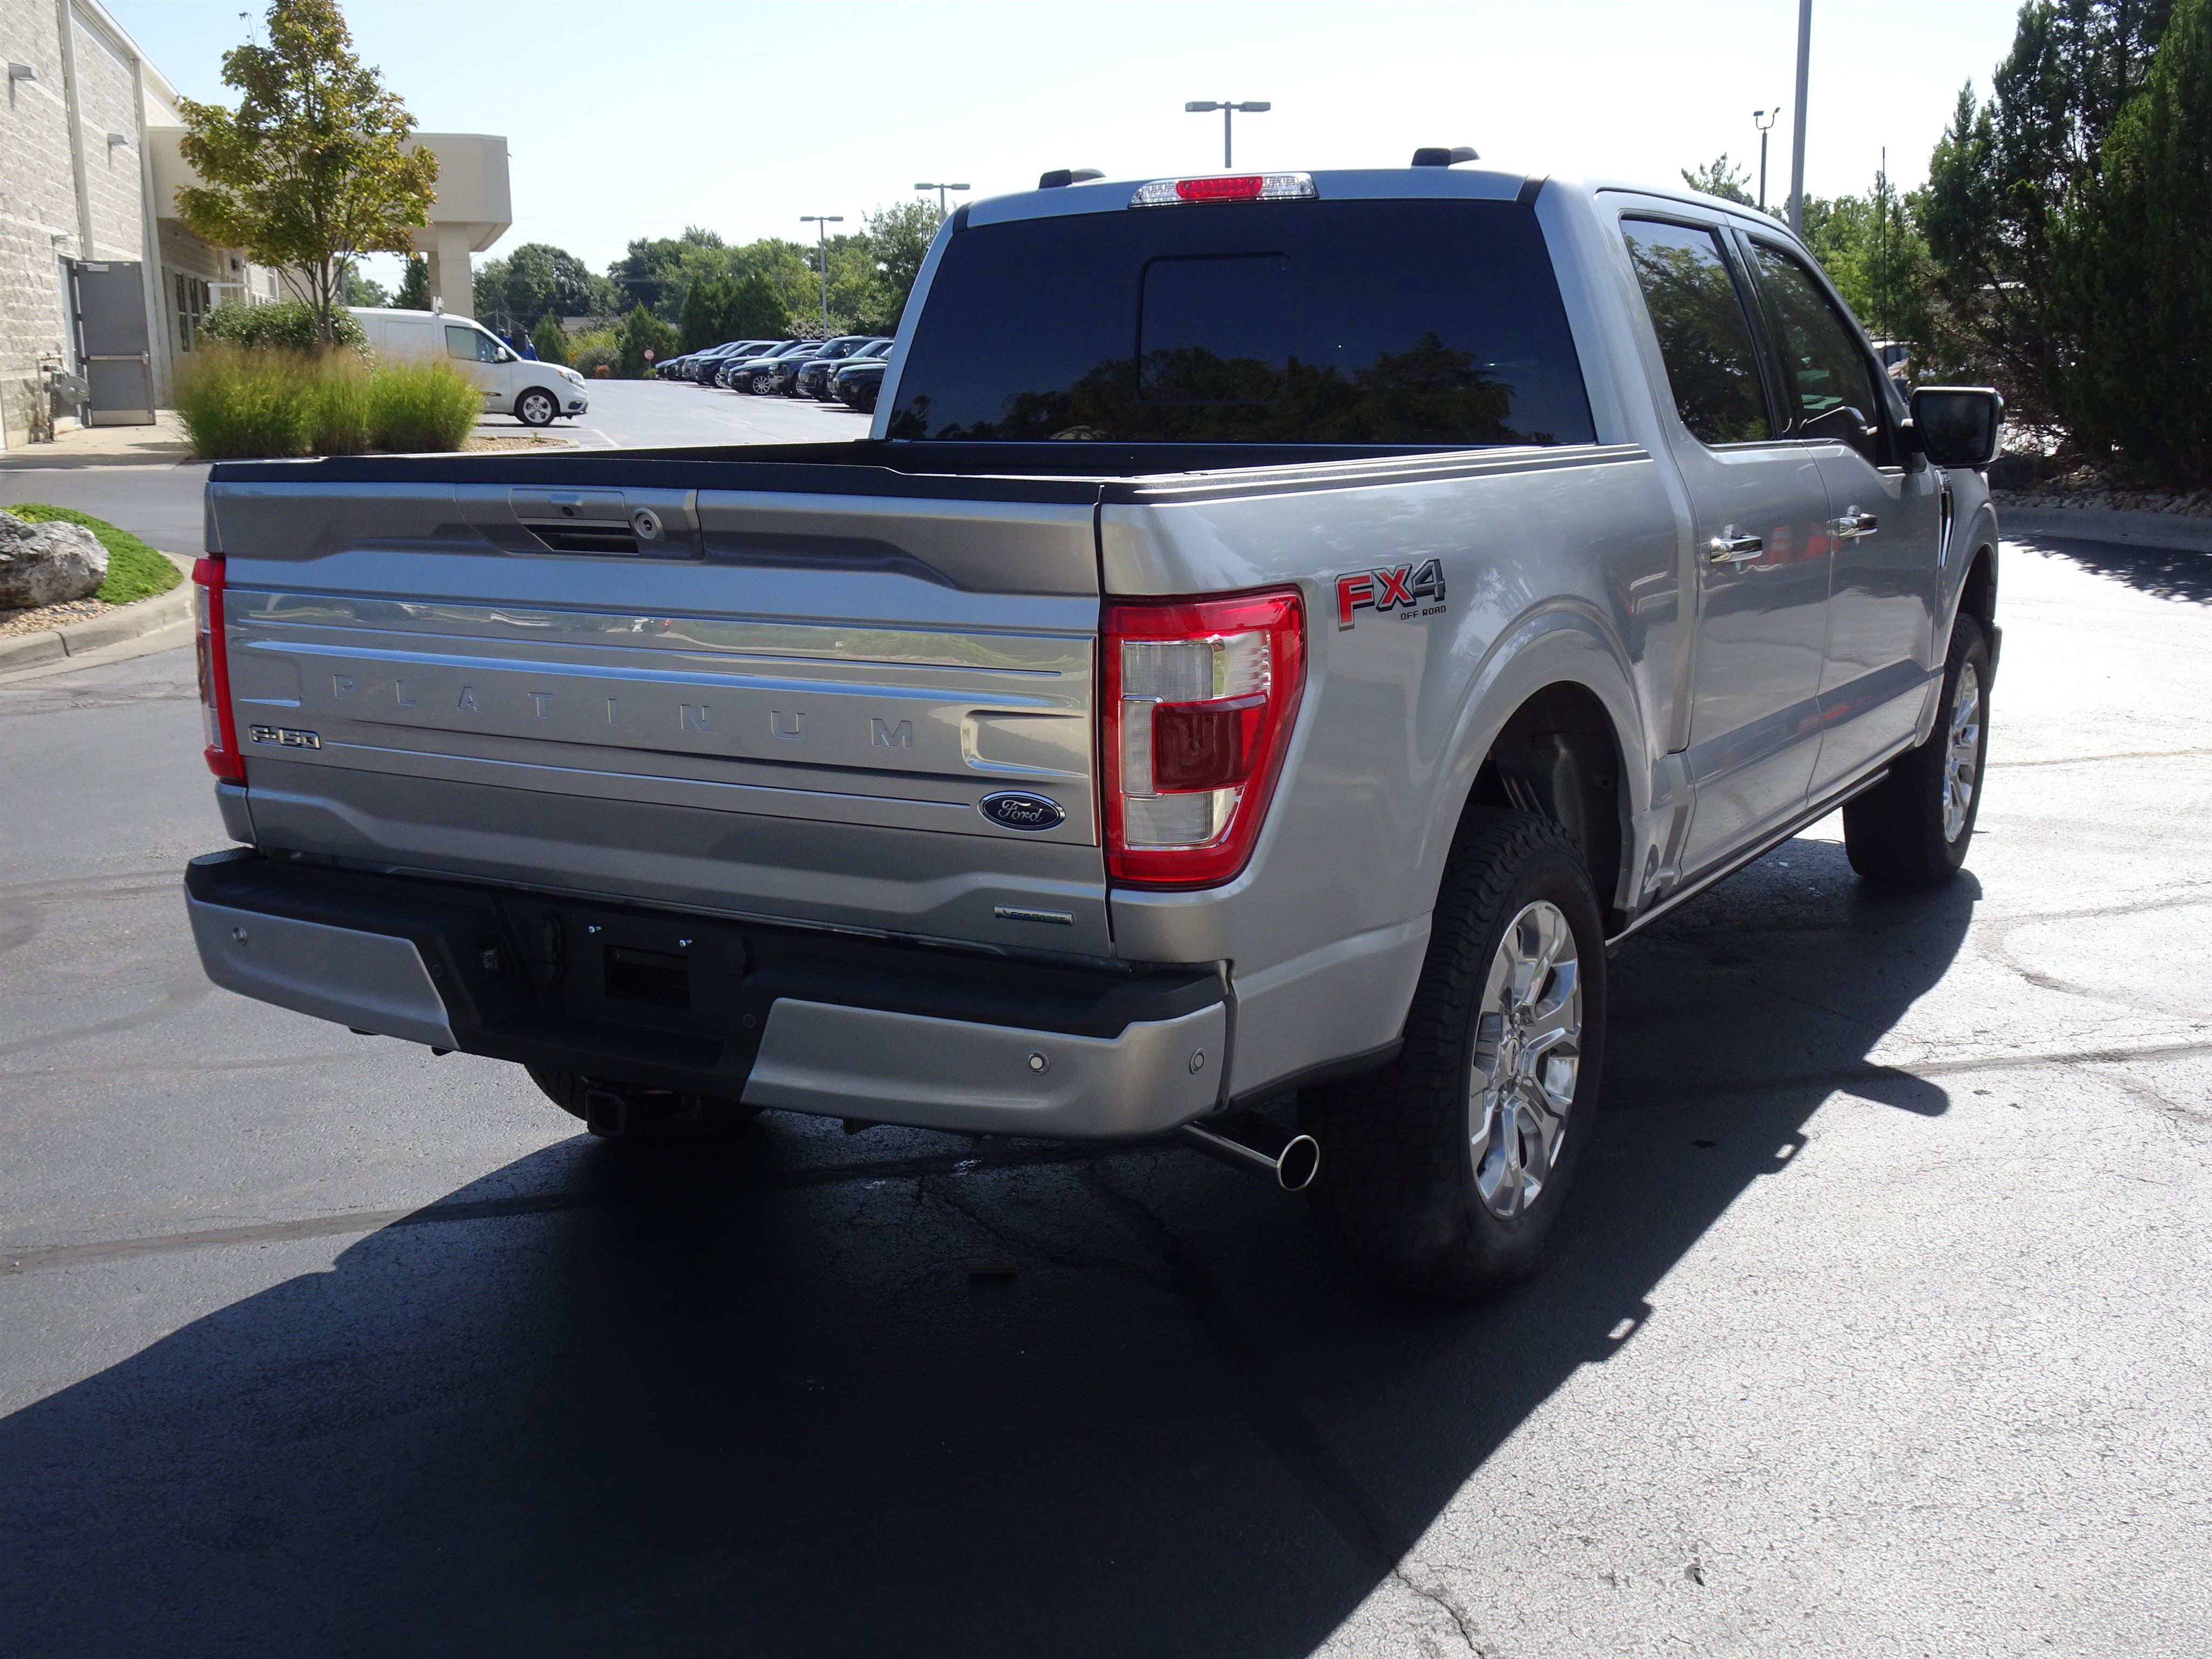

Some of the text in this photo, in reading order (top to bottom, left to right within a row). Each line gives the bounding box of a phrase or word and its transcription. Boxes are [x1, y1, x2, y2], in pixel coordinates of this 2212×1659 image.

[1334, 558, 1446, 632] FX4
[1400, 605, 1446, 621] OFF ROAD
[333, 675, 914, 748] PLATINUM
[248, 724, 321, 751] F-150
[997, 799, 1043, 822] Ford
